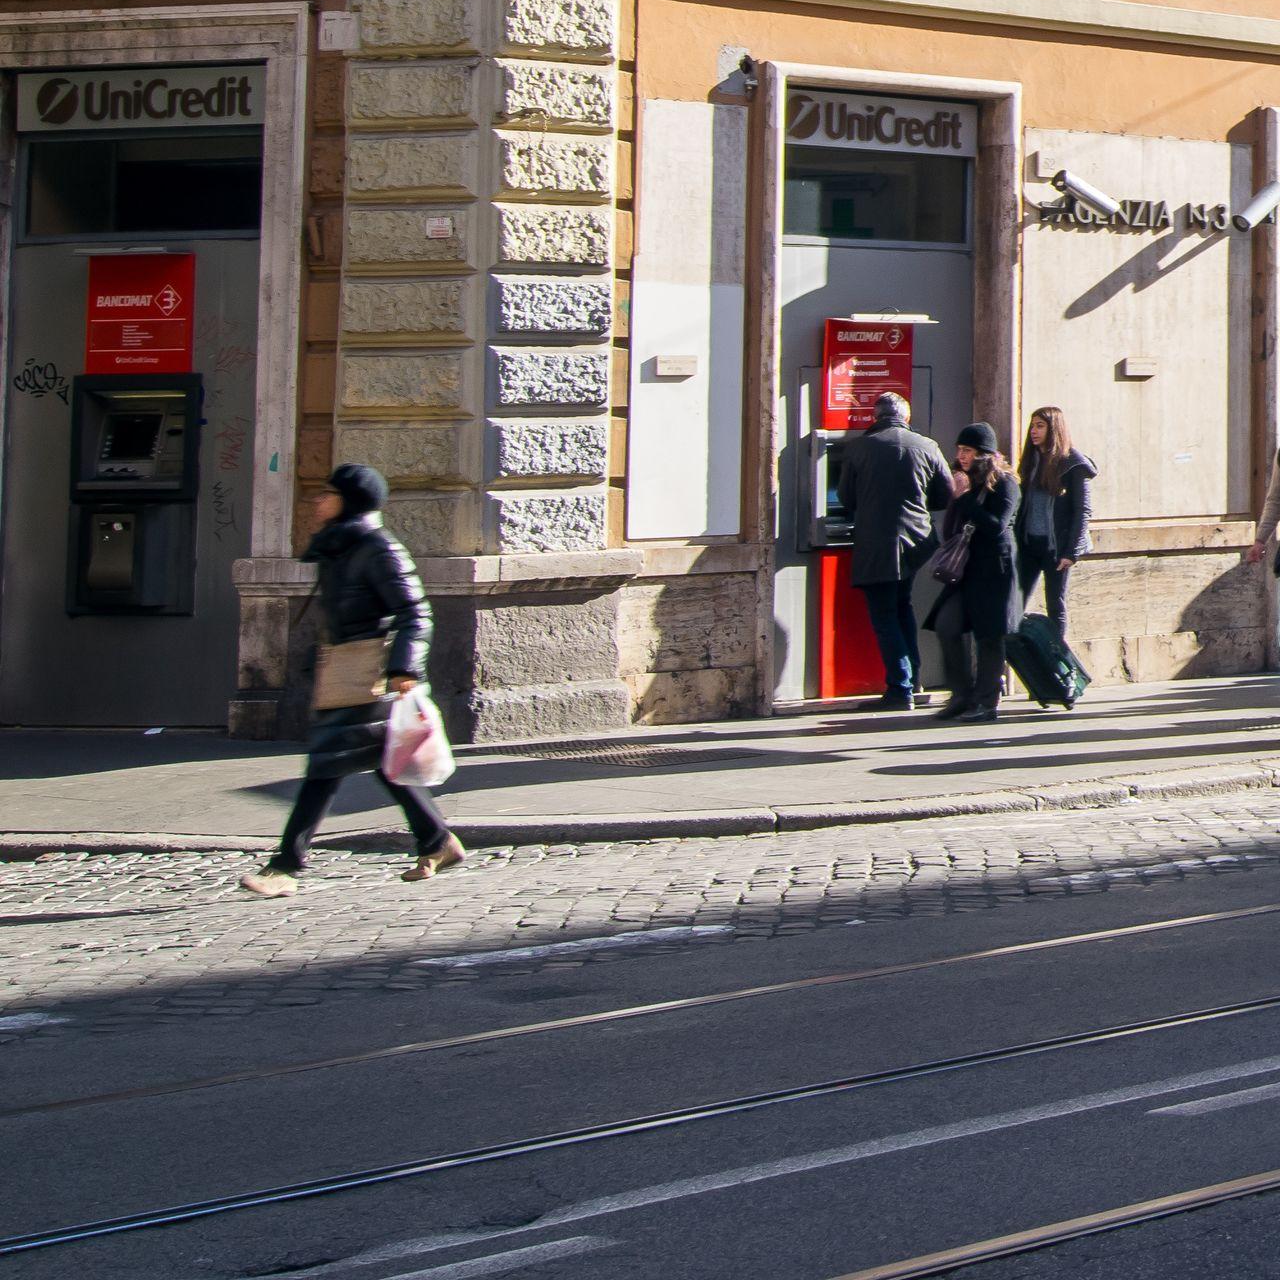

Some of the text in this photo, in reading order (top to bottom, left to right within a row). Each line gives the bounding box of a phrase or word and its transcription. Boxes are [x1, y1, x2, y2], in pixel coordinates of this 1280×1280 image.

[84, 76, 251, 121] UniCredit
[825, 102, 962, 149] UniCredit
[96, 295, 153, 307] BANCOMAT
[837, 331, 885, 342] BANCOMAT
